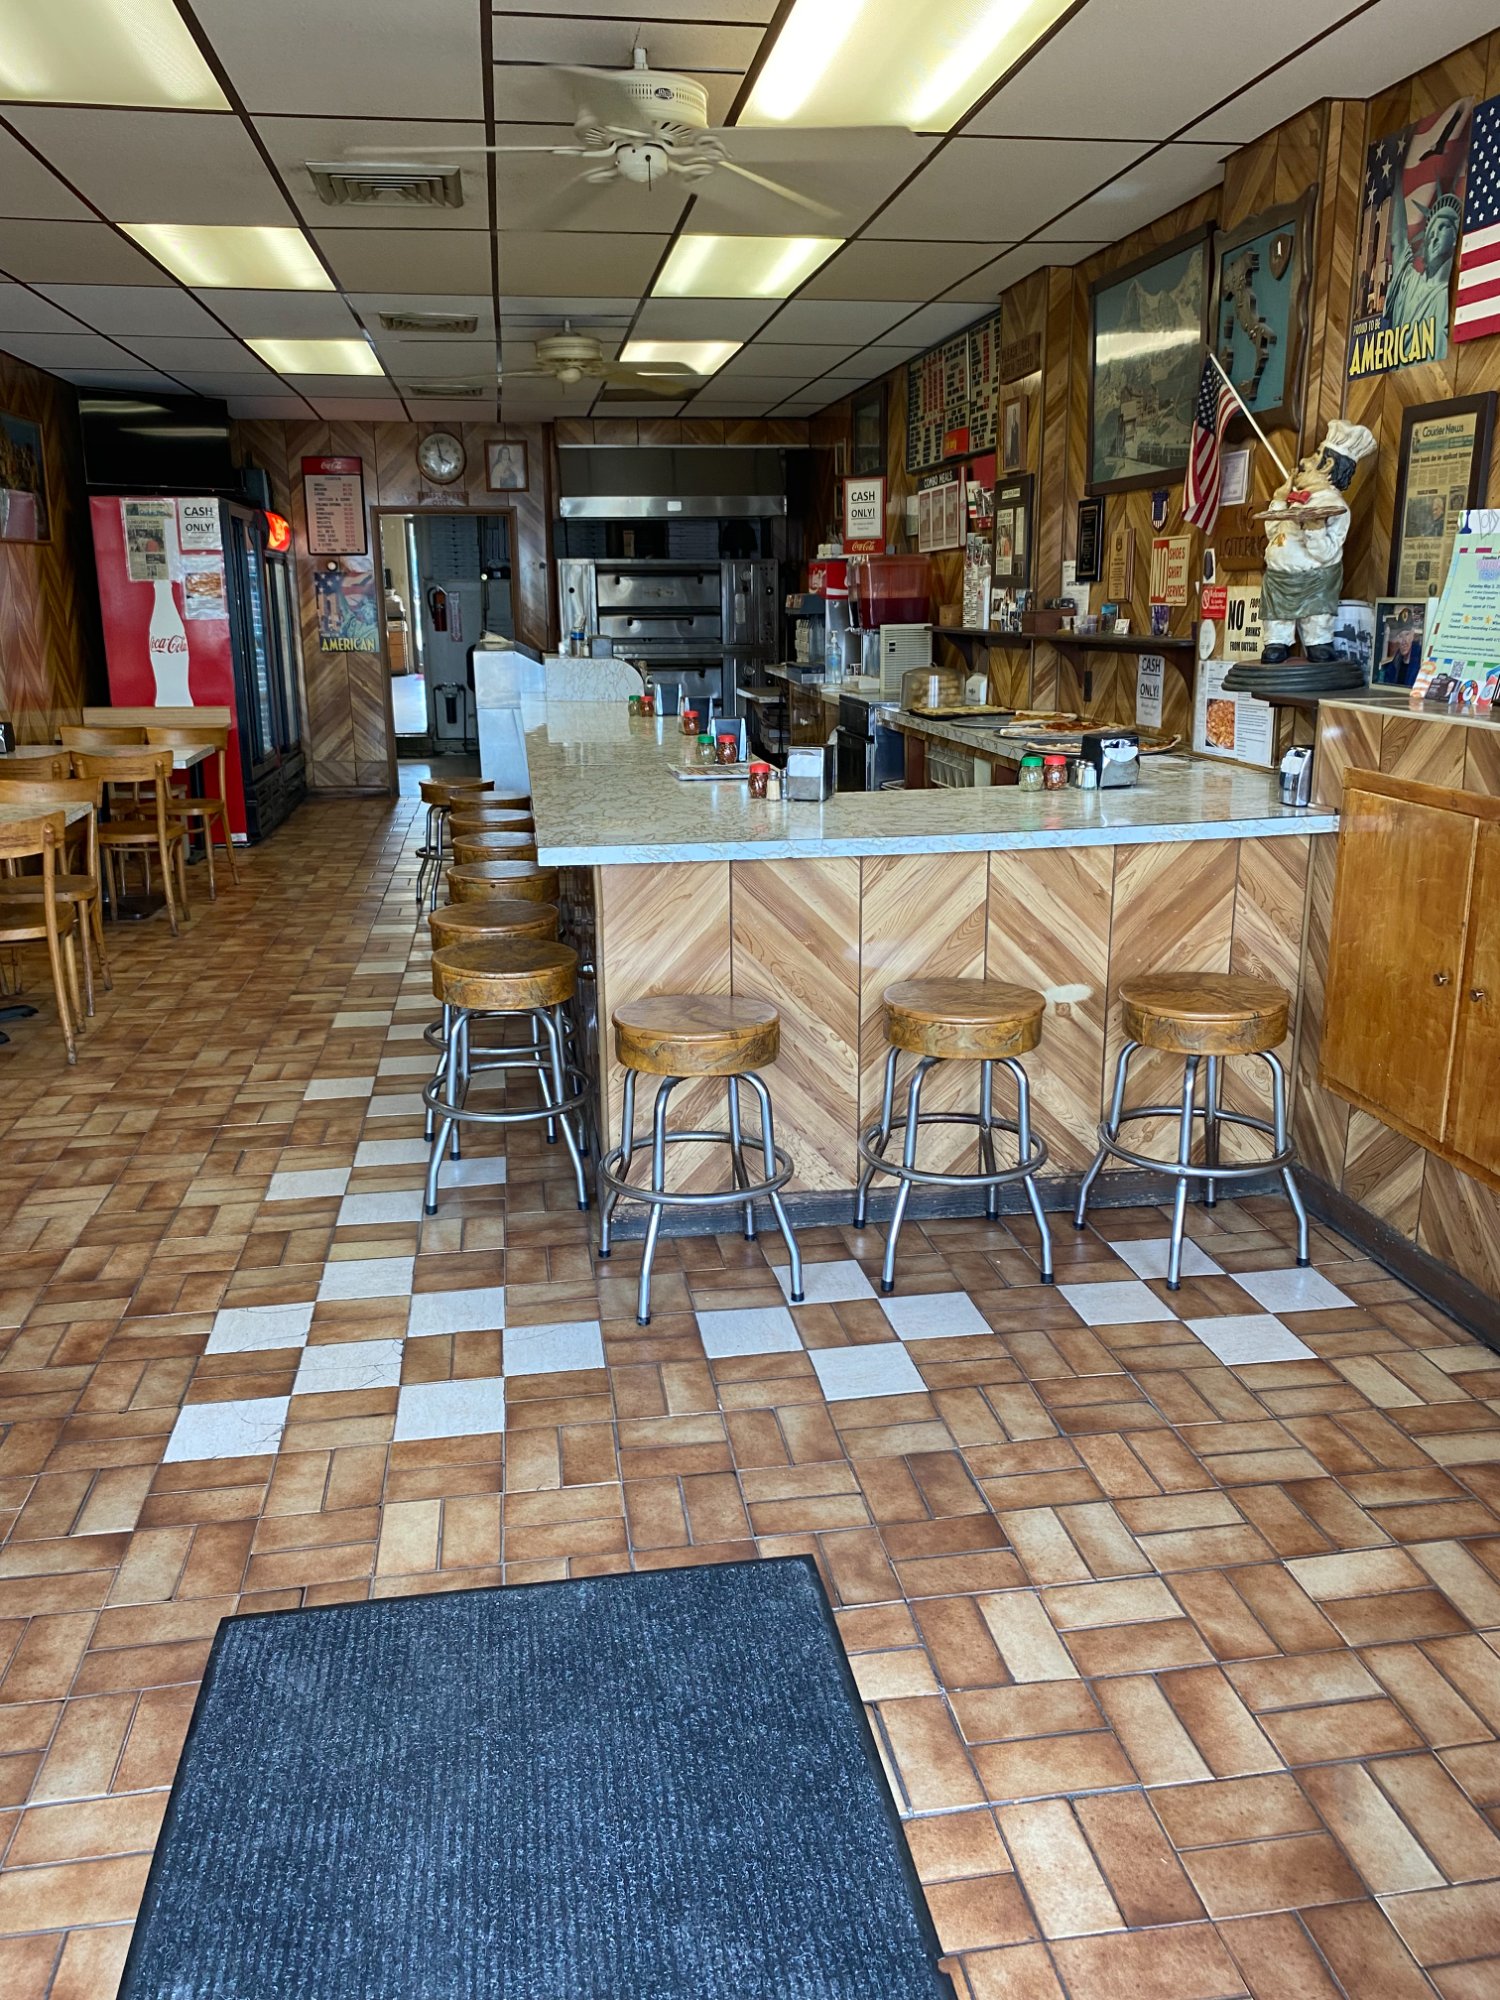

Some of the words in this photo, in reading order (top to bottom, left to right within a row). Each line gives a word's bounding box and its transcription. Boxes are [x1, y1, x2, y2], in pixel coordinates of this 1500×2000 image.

[1353, 321, 1367, 335] PROUD
[1368, 320, 1374, 332] TO
[1374, 318, 1380, 329] BE
[1349, 317, 1435, 376] AMERICAN
[1422, 425, 1445, 438] Courier
[1445, 423, 1464, 434] News
[924, 475, 938, 488] COMBO
[939, 470, 953, 482] MEALS
[851, 491, 875, 501] CASH
[184, 507, 213, 516] CASH
[851, 508, 875, 518] ONLY!
[185, 523, 214, 532] ONLY!
[851, 541, 875, 552] Coca-Cola
[1169, 546, 1186, 560] SHOES
[1152, 547, 1168, 598] NO
[1168, 566, 1182, 578] SHIRT
[1166, 584, 1185, 597] SERVICE
[1228, 599, 1245, 630] NO
[1251, 612, 1257, 622] OR
[1245, 626, 1261, 637] DRINKS
[321, 637, 375, 651] AMERICAN
[1230, 642, 1241, 652] FROM
[1241, 642, 1258, 652] OUTSIDE
[1142, 658, 1160, 672] CASH
[1140, 684, 1159, 698] ONLY!
